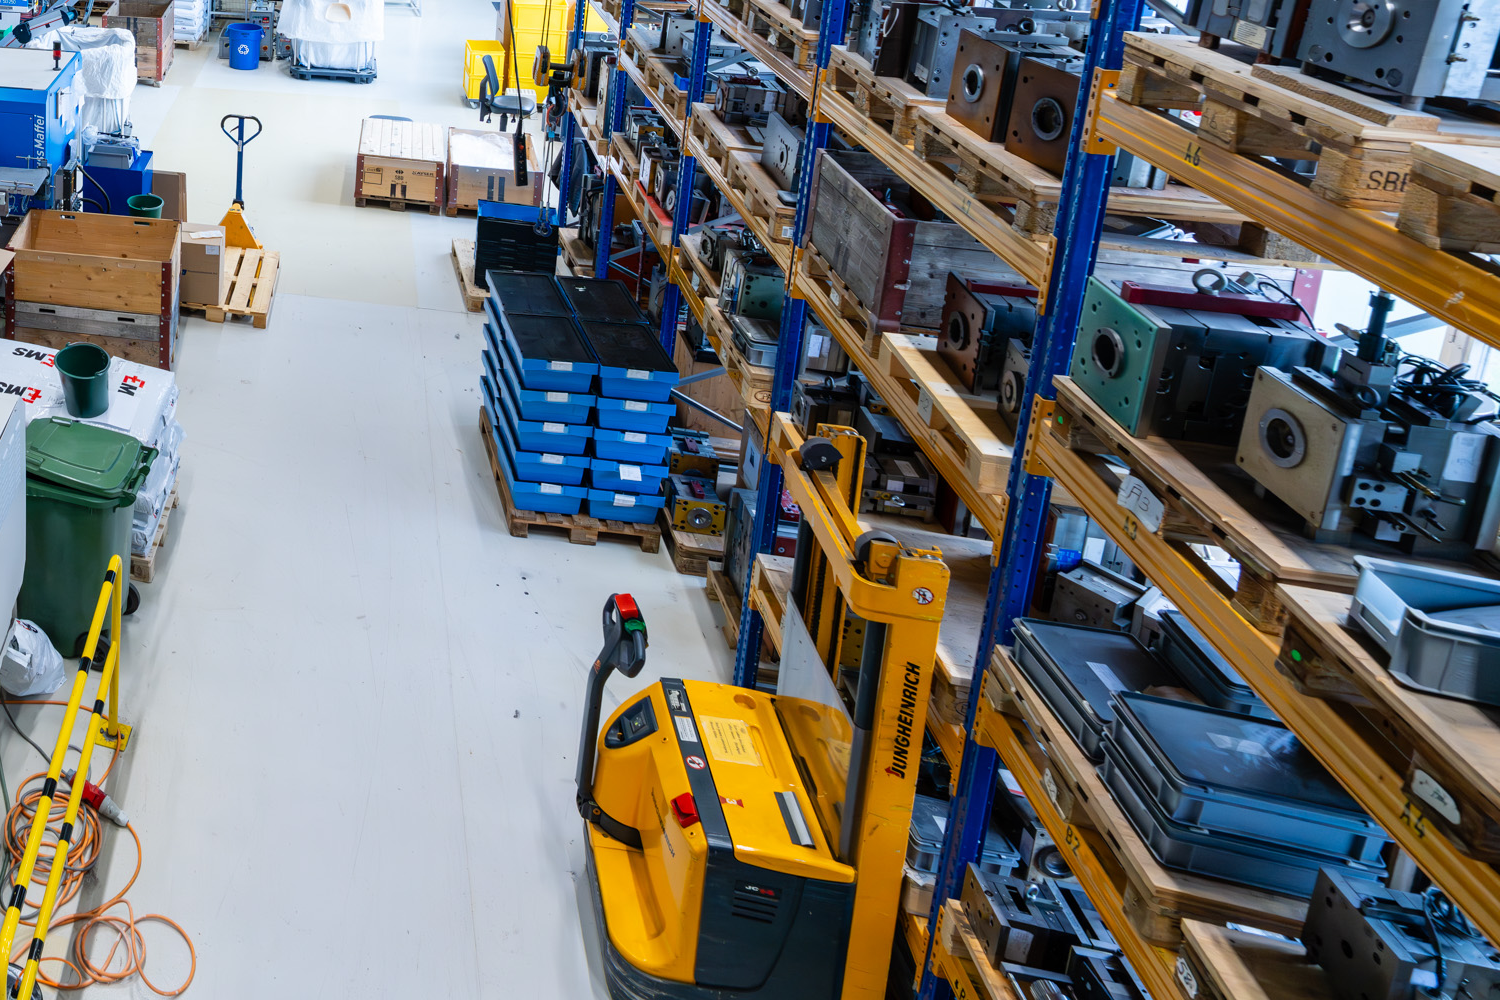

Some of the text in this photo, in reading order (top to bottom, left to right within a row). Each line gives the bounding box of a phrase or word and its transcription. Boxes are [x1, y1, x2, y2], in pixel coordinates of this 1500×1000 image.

[117, 375, 146, 397] EM
[887, 661, 921, 780] JUNGHEINRICH
[1399, 801, 1427, 839] A4
